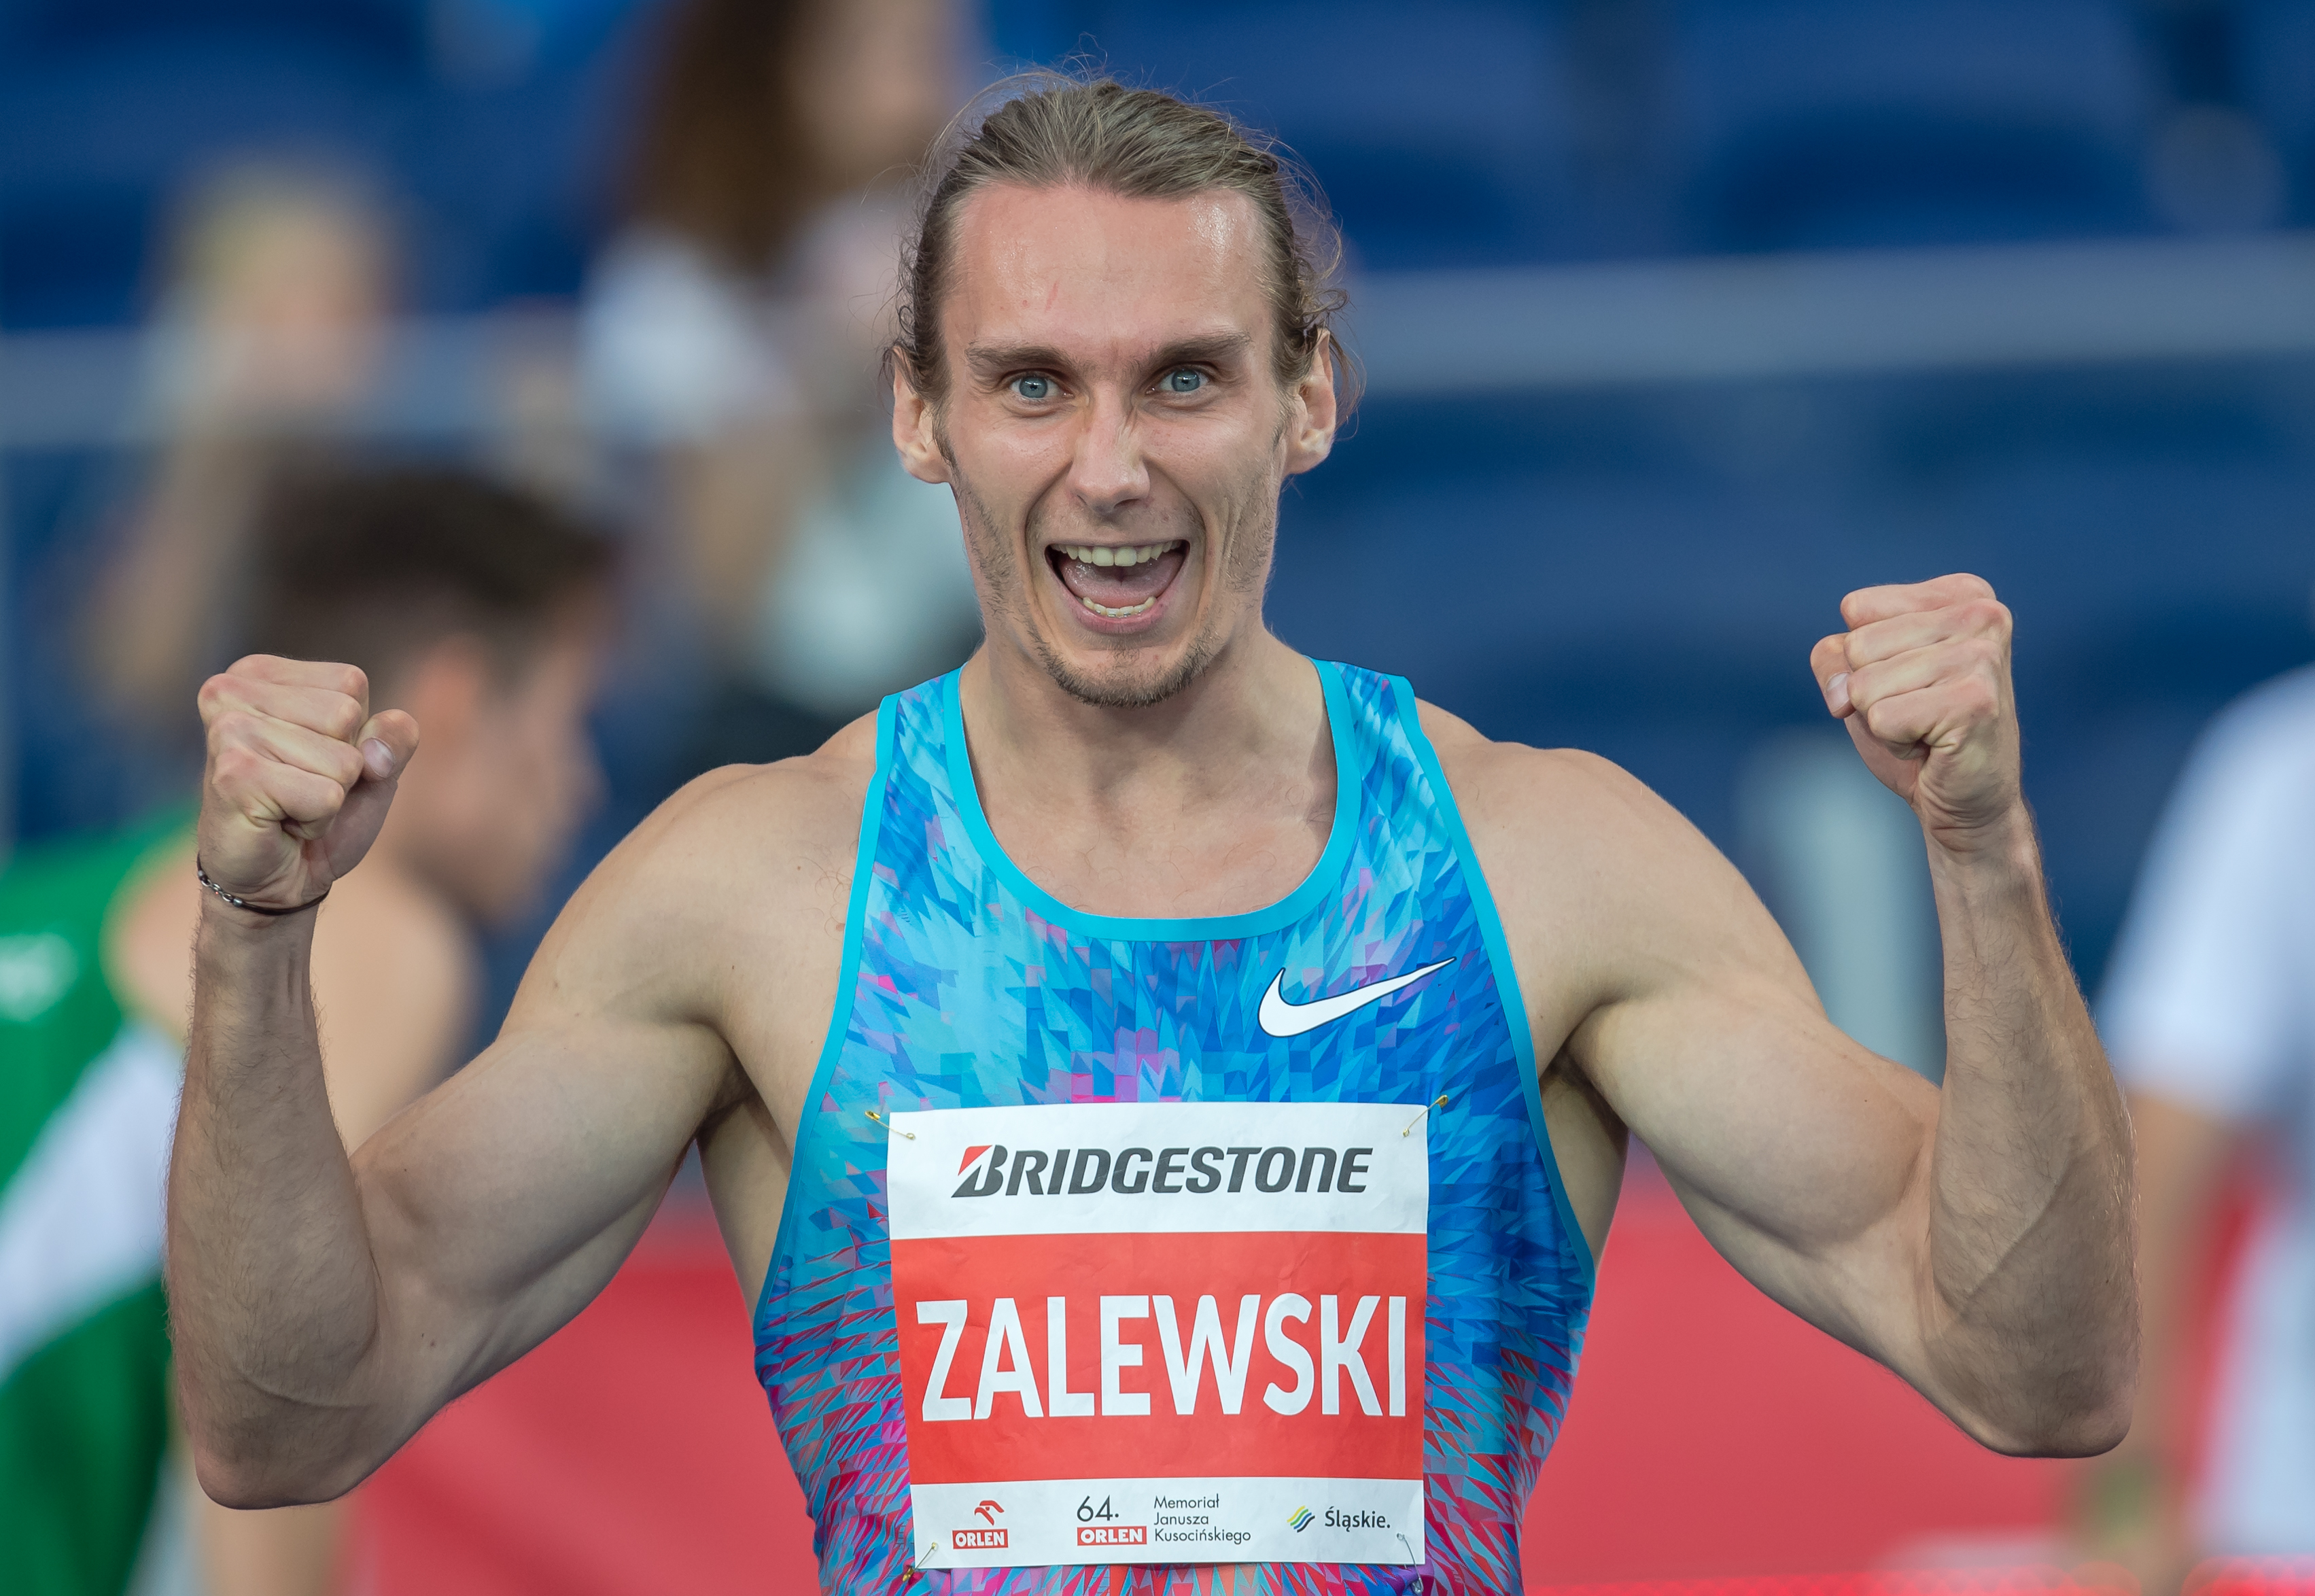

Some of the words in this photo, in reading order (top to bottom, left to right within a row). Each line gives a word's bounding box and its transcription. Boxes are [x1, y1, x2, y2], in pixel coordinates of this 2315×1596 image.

[952, 1144, 1374, 1198] BRIDGESTONE
[915, 1292, 1406, 1422] ZALEWSKI
[1077, 1494, 1119, 1523] 64.
[1153, 1493, 1219, 1509] Memoriał
[1153, 1512, 1209, 1525] Janusza
[1325, 1506, 1391, 1532] Śląskie.
[955, 1531, 1005, 1548] ORLEN
[1080, 1528, 1143, 1544] ORLEN
[1155, 1526, 1251, 1545] Kusocińskiego
